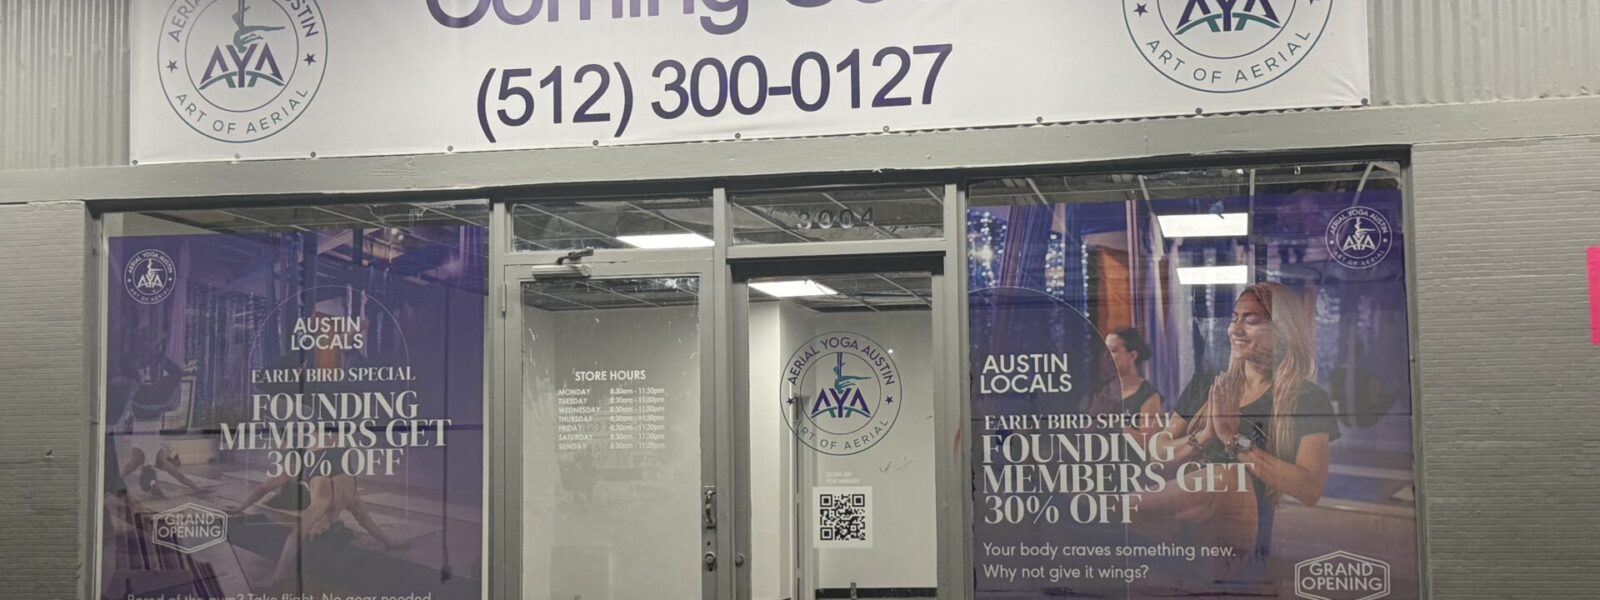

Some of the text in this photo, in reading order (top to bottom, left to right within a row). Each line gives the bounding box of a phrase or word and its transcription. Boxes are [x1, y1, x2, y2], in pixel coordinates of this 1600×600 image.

[287, 0, 319, 38] STIN
[199, 42, 286, 90] AYA
[1146, 31, 1311, 84] ART OF AERIAL
[477, 44, 953, 143] (512) 300-0127
[176, 88, 308, 134] ART OF AERIAL
[797, 206, 875, 229] 3004
[1343, 234, 1376, 250] AYA
[137, 274, 163, 288] AYA
[293, 316, 361, 334] AUSTIN
[291, 334, 364, 350] LOCALS
[788, 336, 895, 386] AERIAL YOGA AUSTIN
[982, 353, 1068, 374] AUSTIN
[251, 366, 416, 384] EARLY BIRD SPECIAL
[575, 370, 646, 381] STORE HOURS
[980, 373, 1072, 394] LOCALS
[252, 390, 419, 421] FOUNDING
[811, 387, 871, 418] AYA
[984, 412, 1176, 430] EARLY BIRD SPECIAL
[219, 418, 452, 450] MEMBERS GET
[820, 439, 837, 450] OF
[844, 420, 888, 450] AERIAL
[981, 431, 1175, 464] FOUNDING
[266, 448, 404, 477] 30% OFF
[982, 461, 1255, 494] MEMBERS GET
[164, 512, 215, 525] GRAND
[984, 493, 1142, 525] 30% OFF
[158, 525, 221, 538] OPENING
[983, 542, 1236, 561] Your body craves something new.
[982, 563, 1149, 583] Why not give it wings?
[1309, 562, 1373, 576] GRAND
[1301, 576, 1382, 591] OPENING
